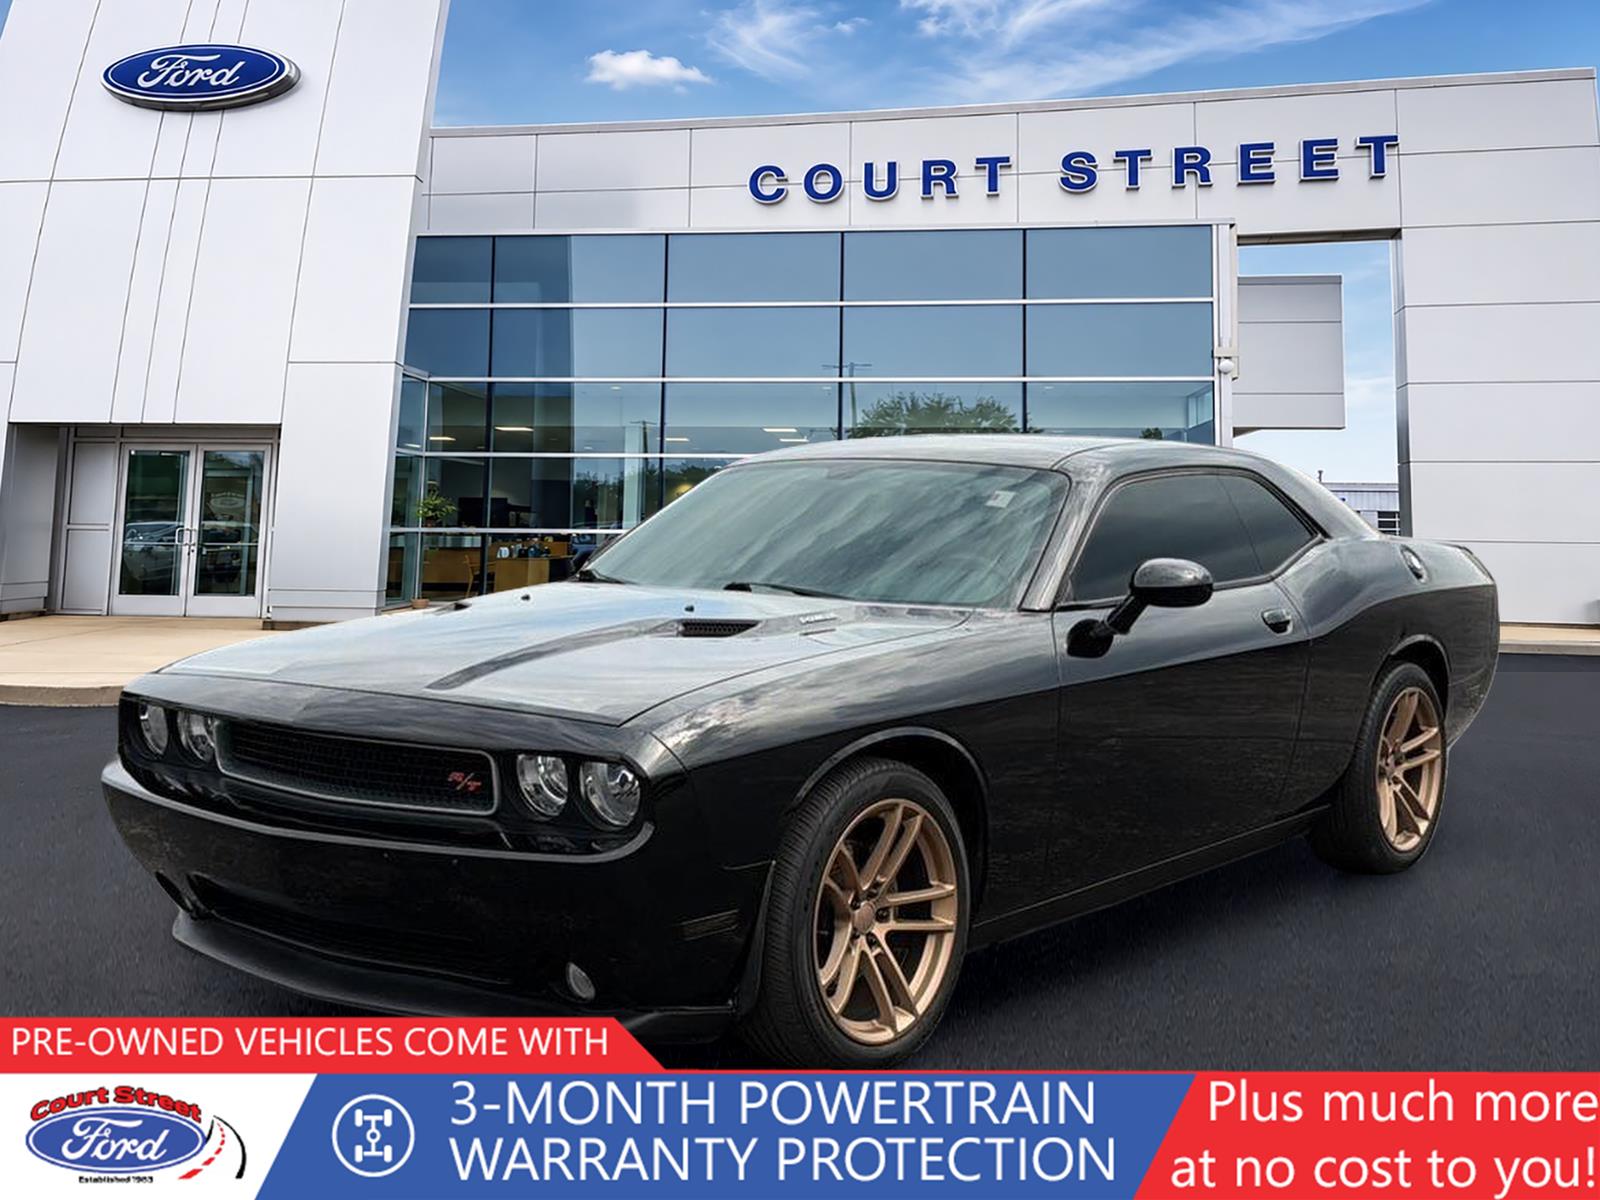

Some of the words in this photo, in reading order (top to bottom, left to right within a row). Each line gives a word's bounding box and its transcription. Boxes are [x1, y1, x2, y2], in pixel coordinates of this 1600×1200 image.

[137, 54, 246, 88] Ford
[748, 155, 1012, 203] COURT
[1058, 134, 1400, 194] STREET
